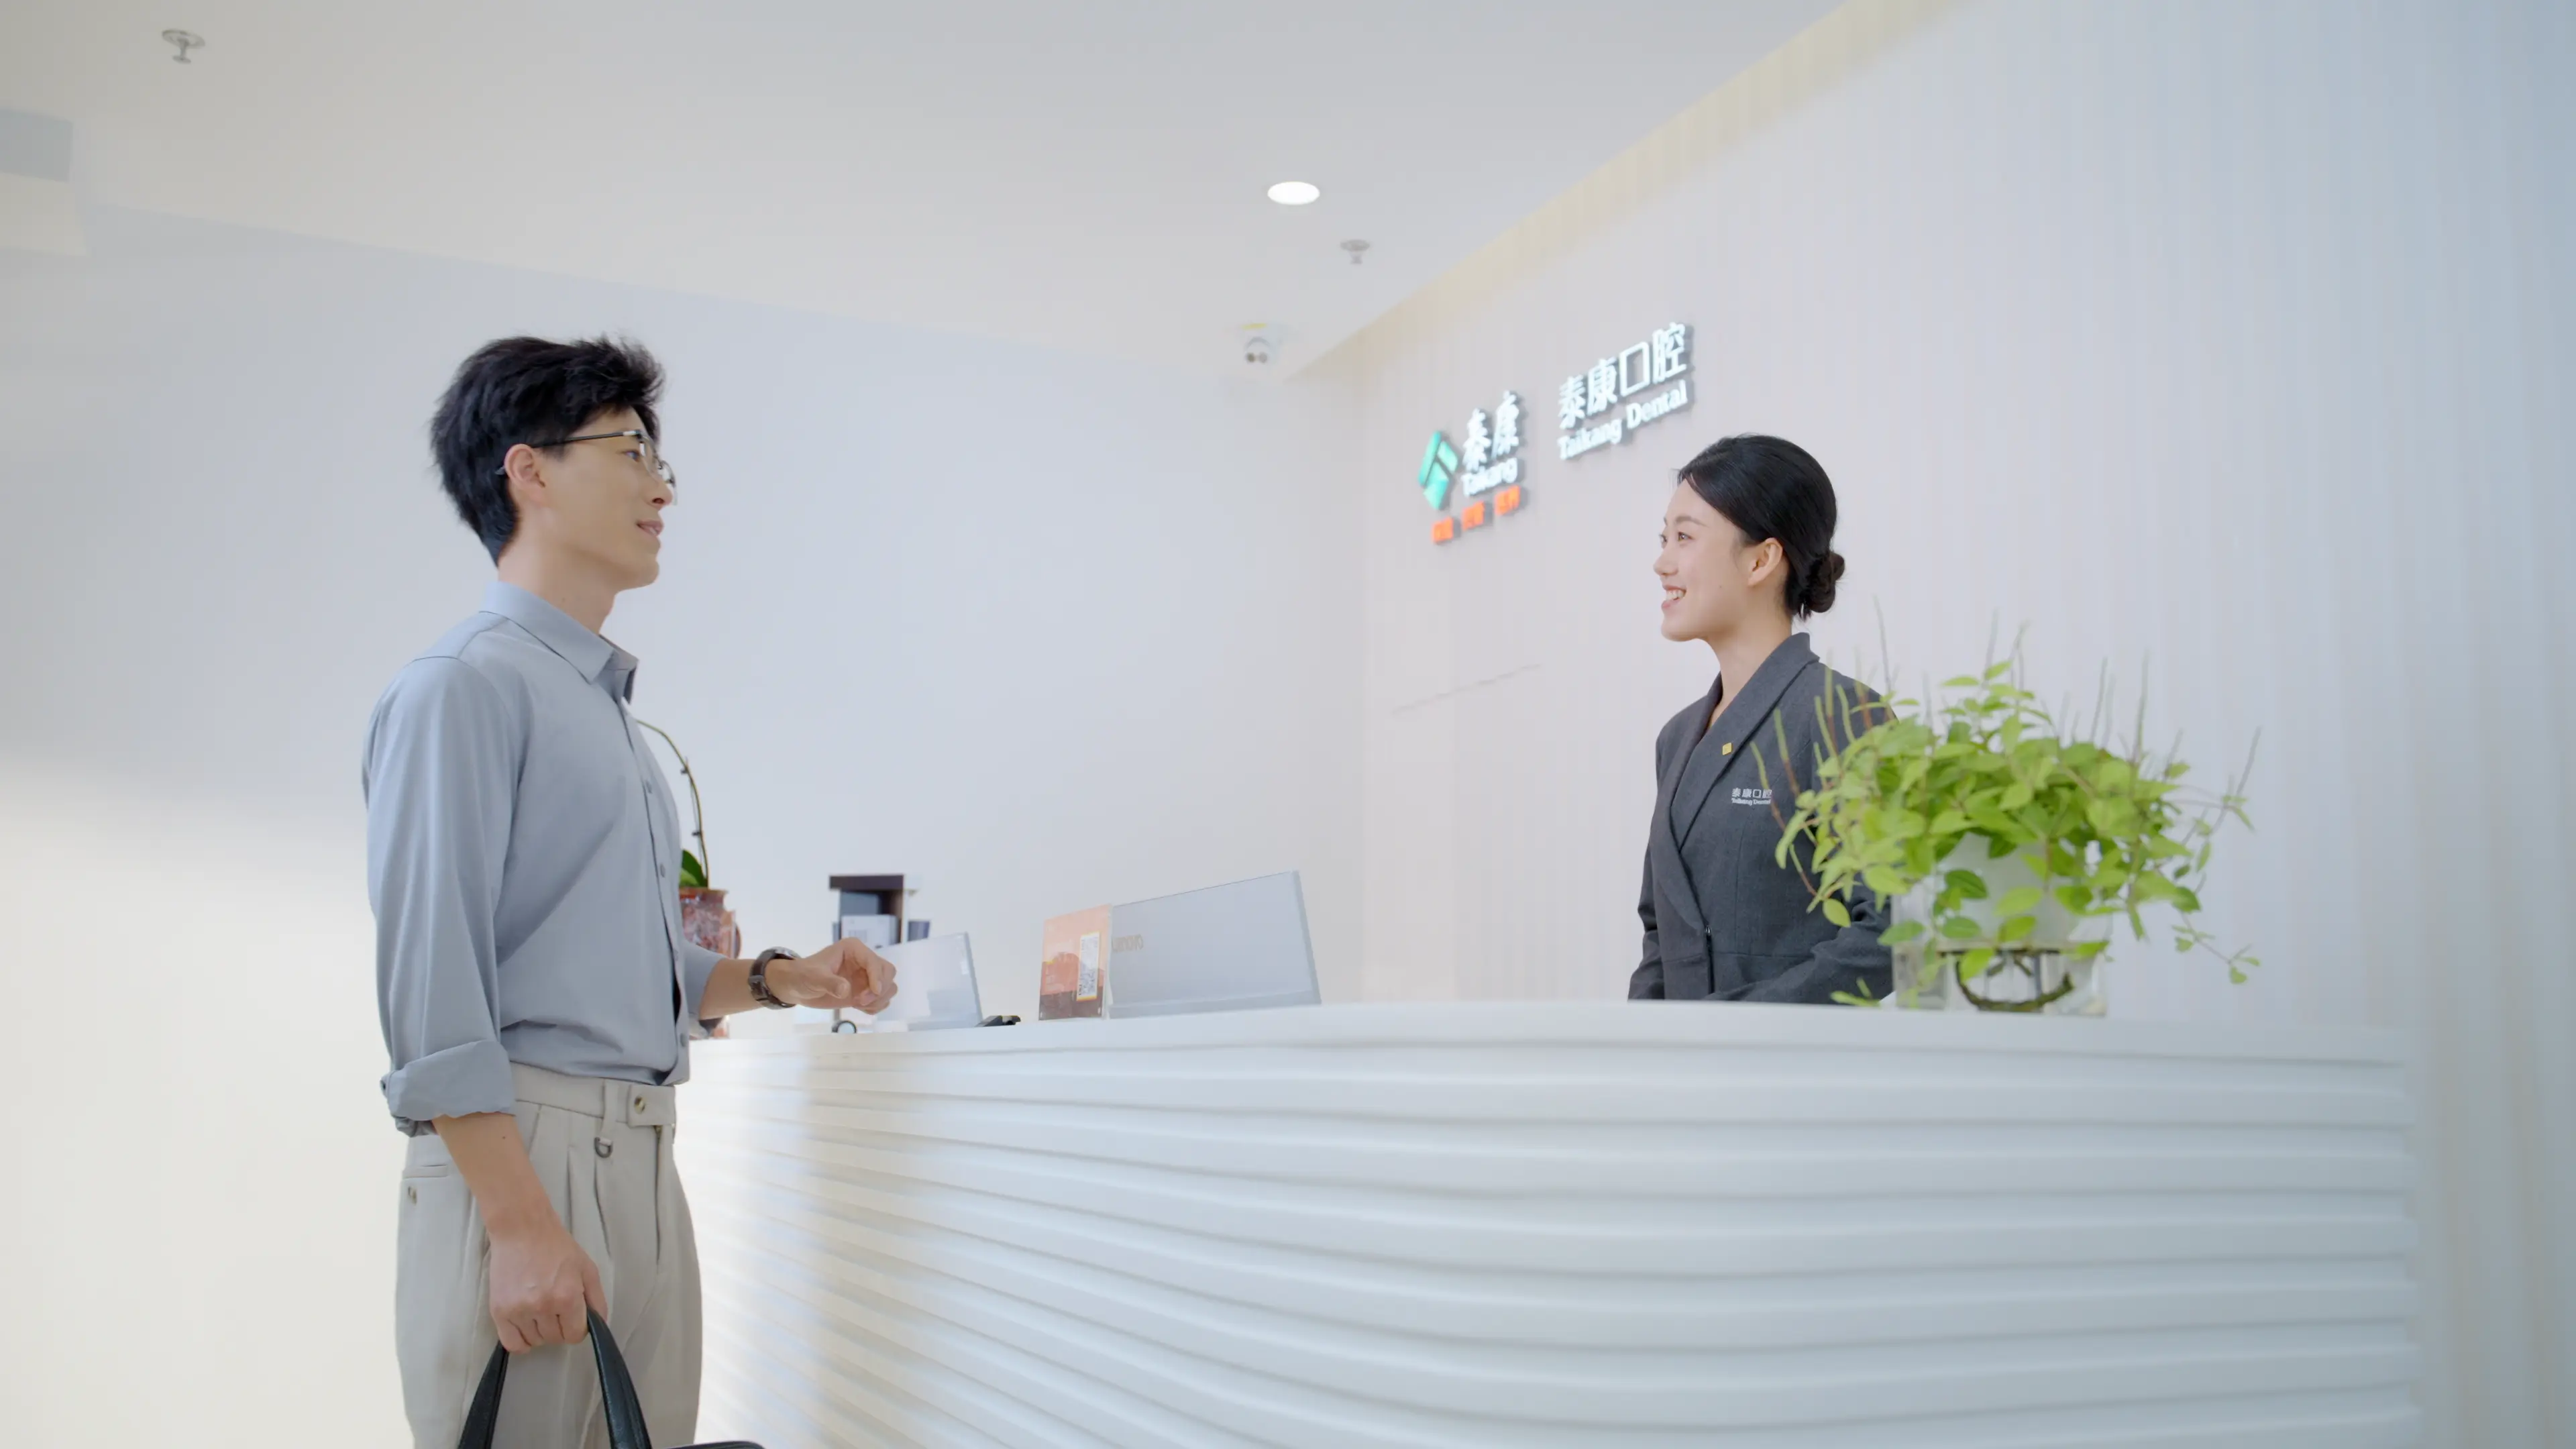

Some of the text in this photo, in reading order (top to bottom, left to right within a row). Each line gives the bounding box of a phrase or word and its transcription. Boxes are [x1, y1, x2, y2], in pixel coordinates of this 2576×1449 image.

[1557, 379, 1688, 460] Taikang Dental
[1558, 322, 1687, 429] 泰康口腔
